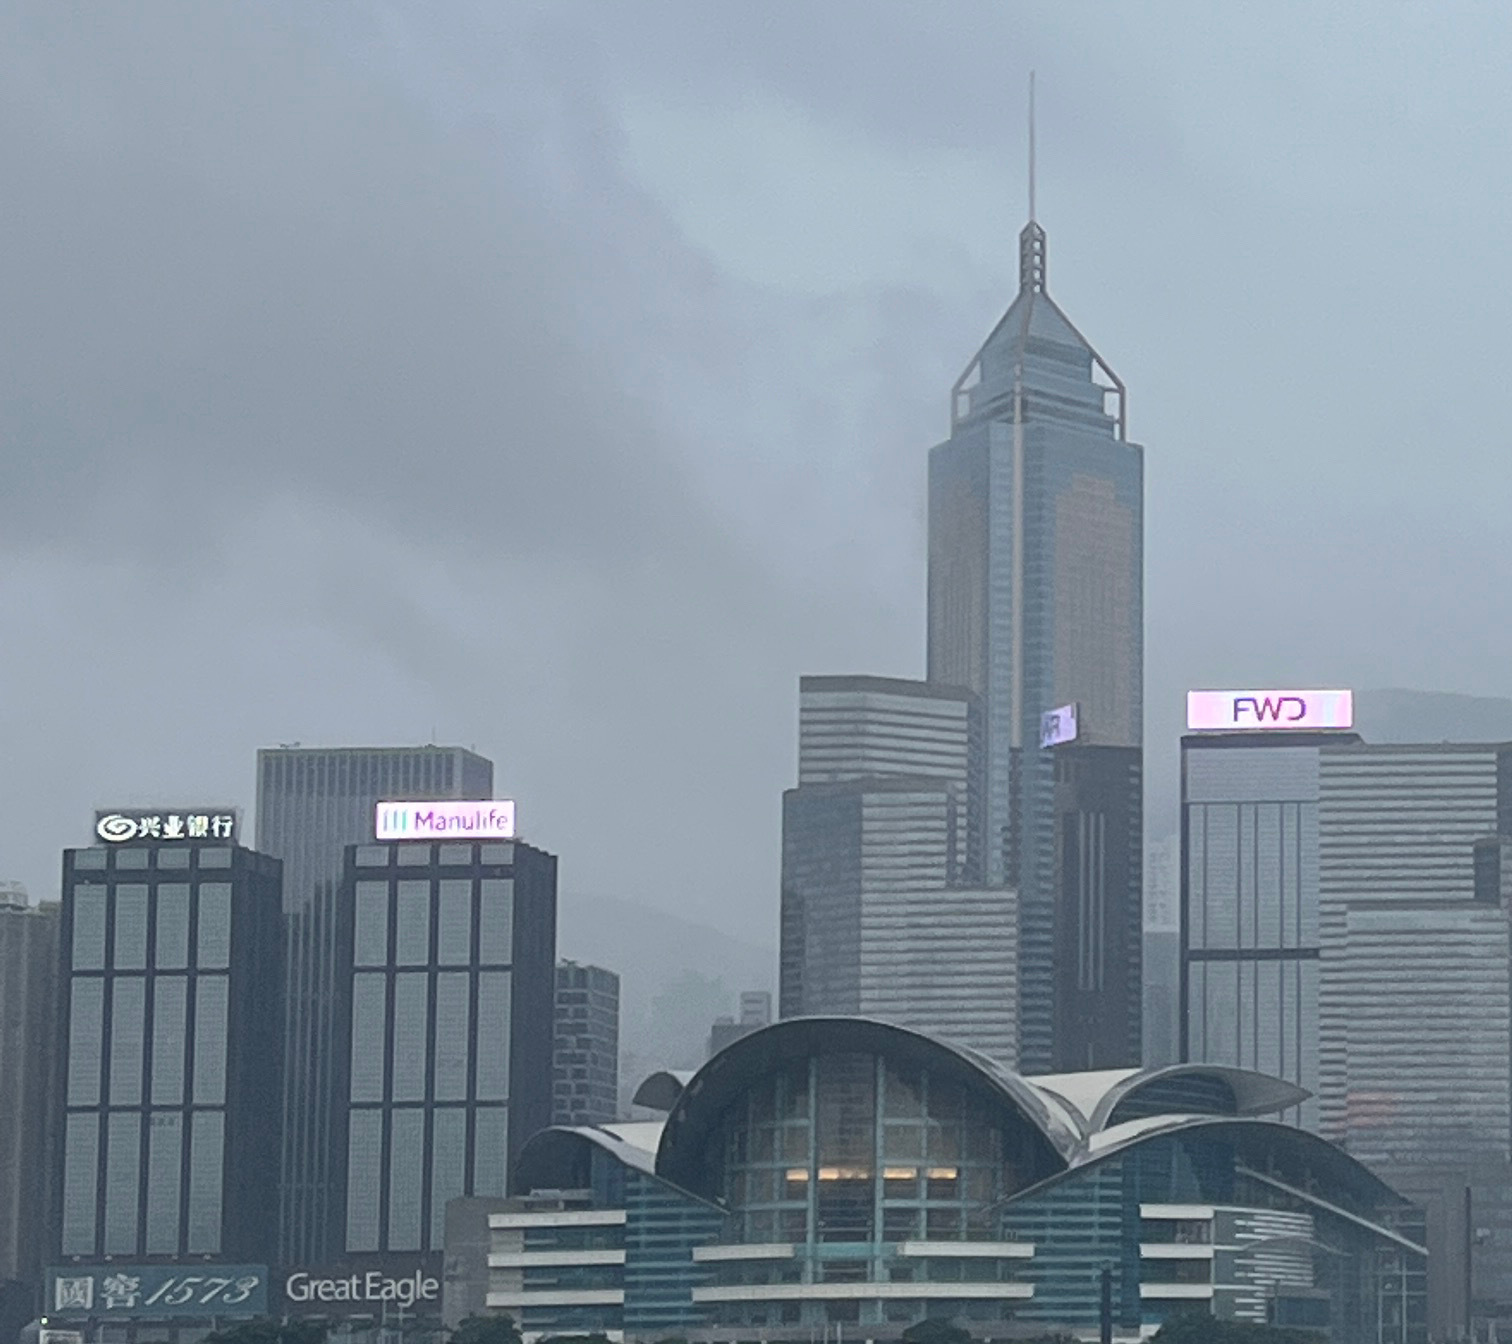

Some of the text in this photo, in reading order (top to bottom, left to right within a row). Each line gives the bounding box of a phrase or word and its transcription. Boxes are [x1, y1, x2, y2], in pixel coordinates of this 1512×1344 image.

[1233, 697, 1307, 722] FWD
[137, 814, 234, 839] 兴业银行
[414, 808, 508, 832] Manulife
[286, 1269, 439, 1307] Great Eagle
